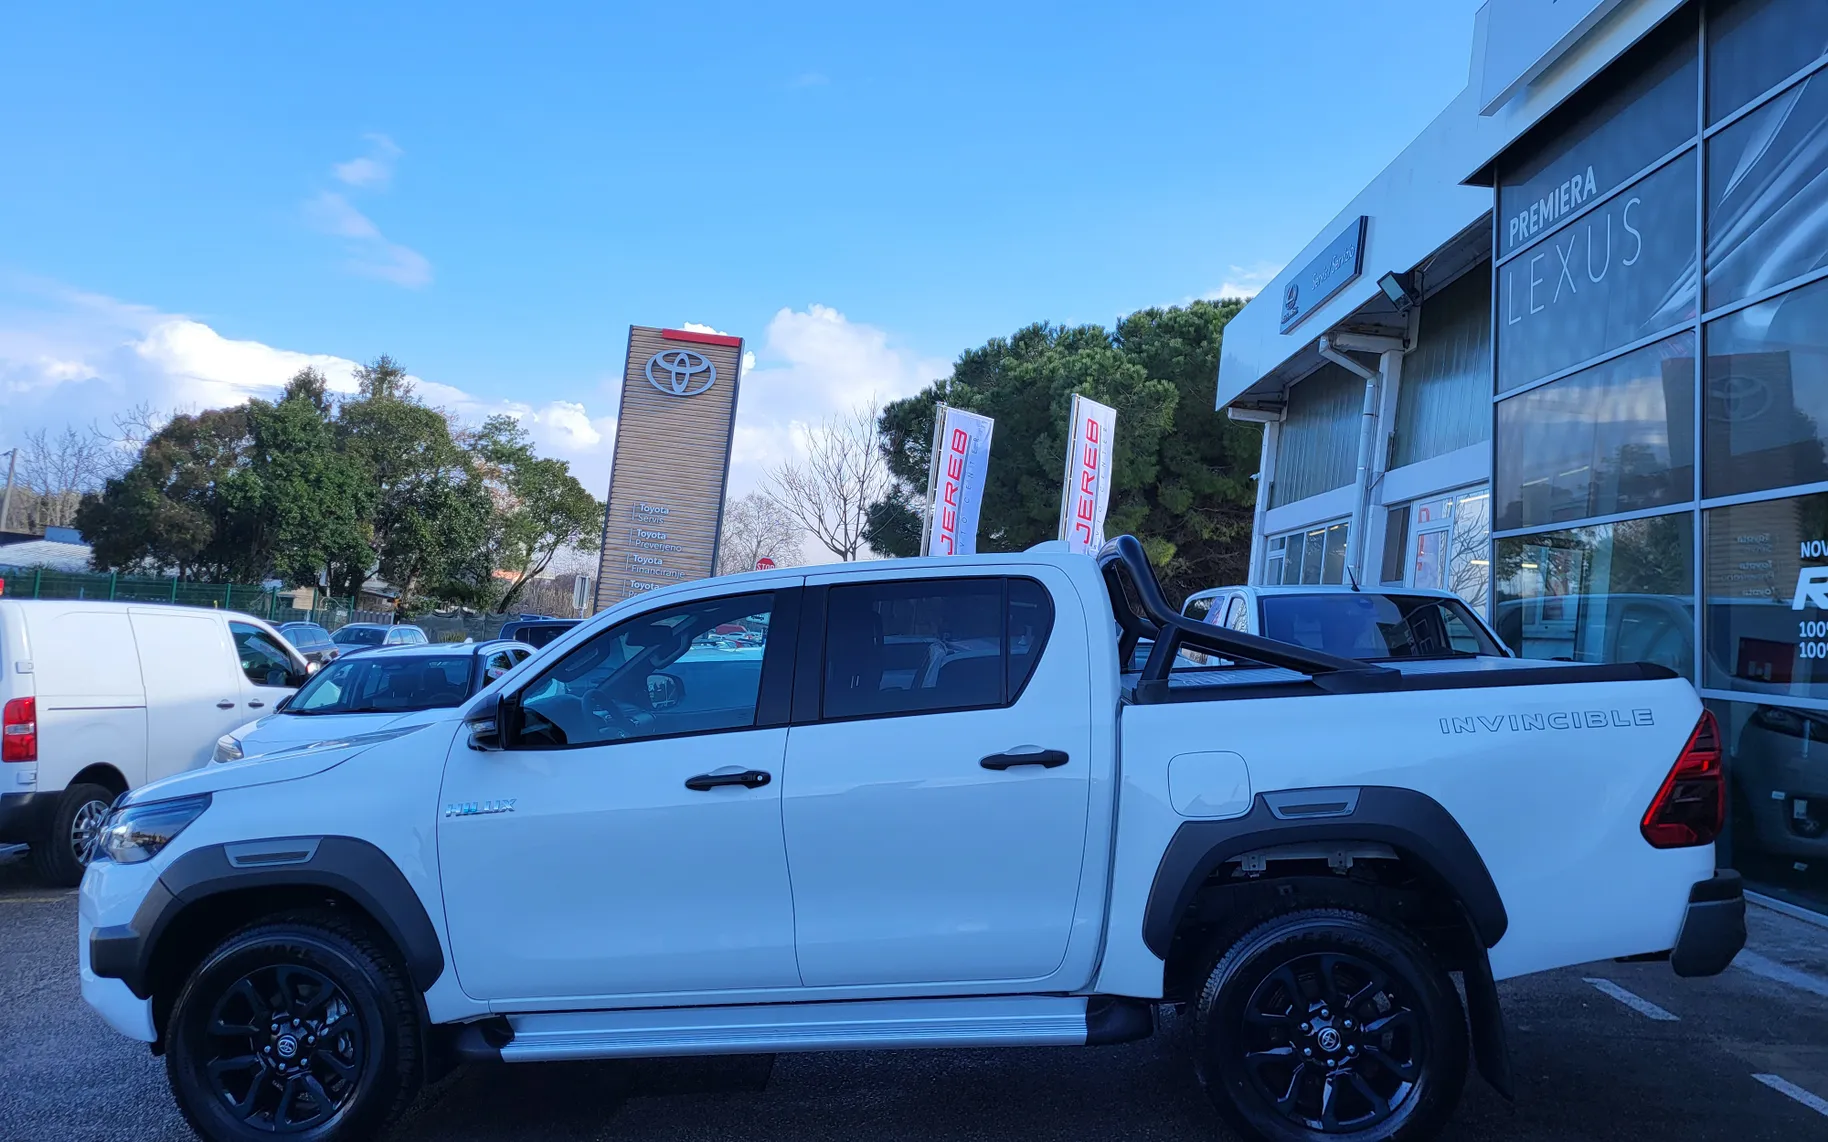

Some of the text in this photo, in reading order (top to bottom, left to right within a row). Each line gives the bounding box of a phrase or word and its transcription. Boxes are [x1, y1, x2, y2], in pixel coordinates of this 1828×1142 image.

[1508, 165, 1598, 248] PREMIERA
[1506, 196, 1644, 326] LEXUS
[1076, 417, 1101, 544] JEREB
[940, 428, 968, 556] JEREB
[639, 502, 670, 516] Toyota
[637, 514, 665, 524] Servis
[636, 528, 667, 542] Toyota
[634, 538, 683, 553] Preverjeno
[633, 554, 664, 567] Toyota
[756, 563, 775, 571] STOP
[631, 565, 686, 580] Financiranje
[630, 579, 660, 591] Toyota
[1799, 621, 1828, 638] 100
[1799, 641, 1828, 659] 100
[1438, 708, 1655, 735] INVINCIBLE
[445, 798, 518, 818] HILUX
